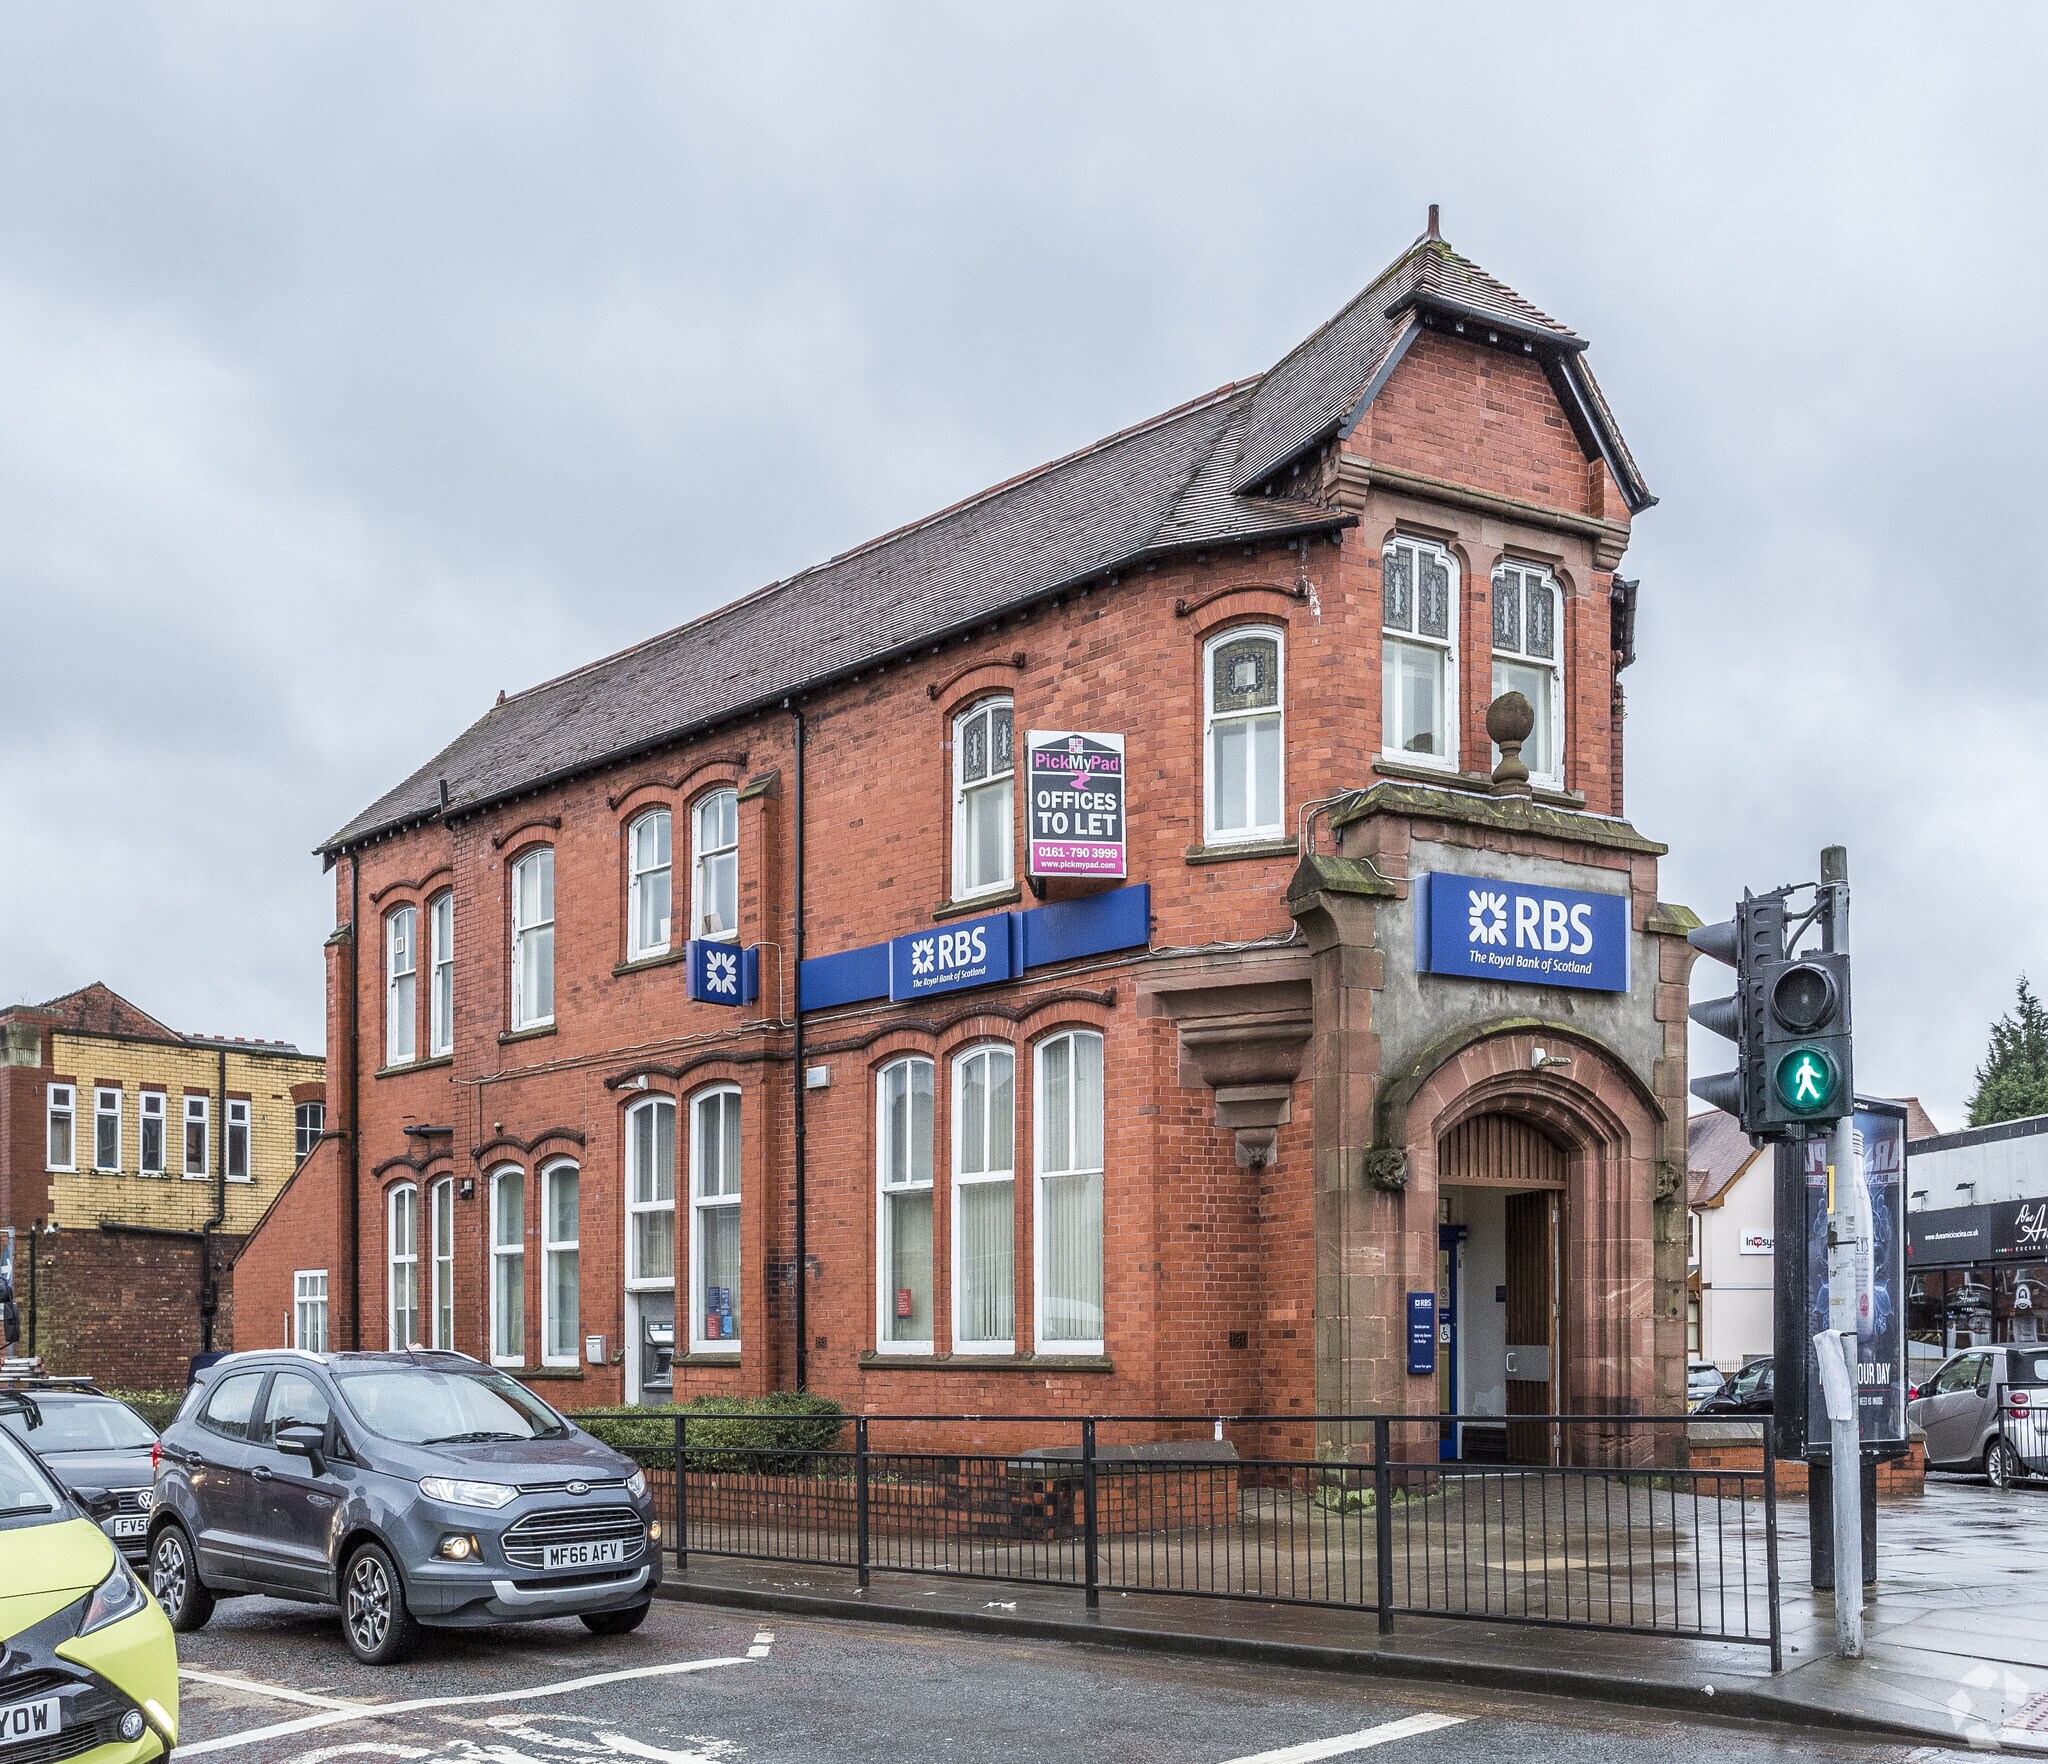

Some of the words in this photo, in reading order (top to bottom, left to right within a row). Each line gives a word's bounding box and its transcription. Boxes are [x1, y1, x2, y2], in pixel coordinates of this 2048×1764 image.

[1035, 752, 1119, 772] PickMyPad
[1037, 790, 1117, 811] OFFICES
[1037, 811, 1069, 834] TO
[1074, 812, 1117, 836] LET
[1092, 847, 1118, 859] 3999
[1040, 860, 1116, 870] www.pickmypad.com
[1515, 896, 1593, 955] RBS
[938, 926, 987, 970] RBS
[1469, 950, 1487, 964] The
[1488, 952, 1514, 969] Royal
[1516, 956, 1540, 970] Bank
[1541, 958, 1553, 974] of
[1553, 959, 1592, 975] Scotland
[912, 979, 923, 988] The
[923, 975, 939, 987] Royal
[939, 973, 954, 983] Bank
[954, 970, 961, 982] of
[961, 966, 987, 979] Scotland
[1420, 1298, 1432, 1307] RBS
[1876, 1362, 1891, 1385] DAY
[550, 1546, 588, 1566] MF66
[592, 1542, 617, 1562] AFV
